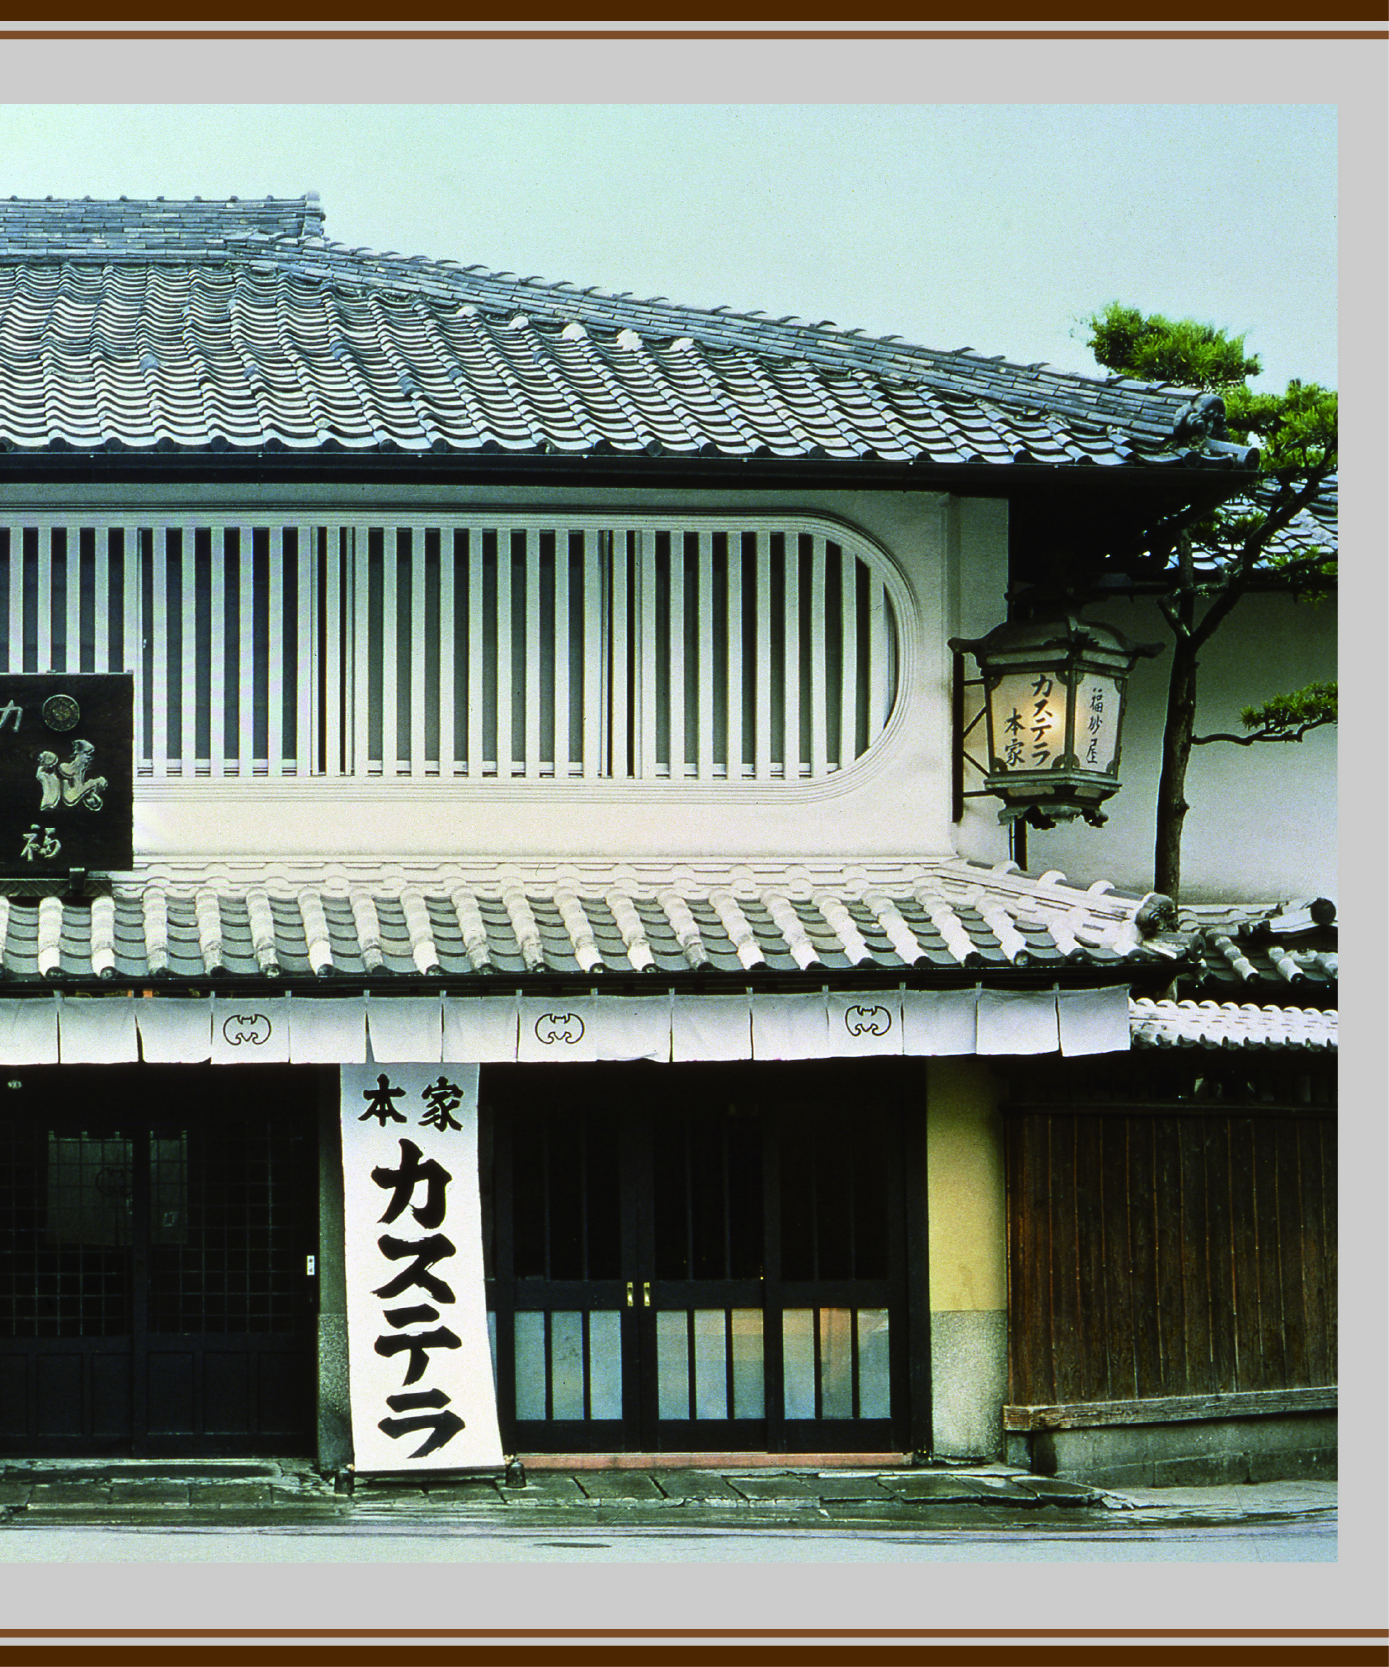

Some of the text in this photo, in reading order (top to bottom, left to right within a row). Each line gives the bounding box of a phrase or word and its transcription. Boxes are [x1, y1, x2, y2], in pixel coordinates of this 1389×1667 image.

[1005, 709, 1025, 766] 本家
[1031, 675, 1053, 766] カステラ
[1087, 688, 1103, 764] 福砂屋
[357, 1073, 464, 1133] 本家
[371, 1138, 466, 1458] カステラ
